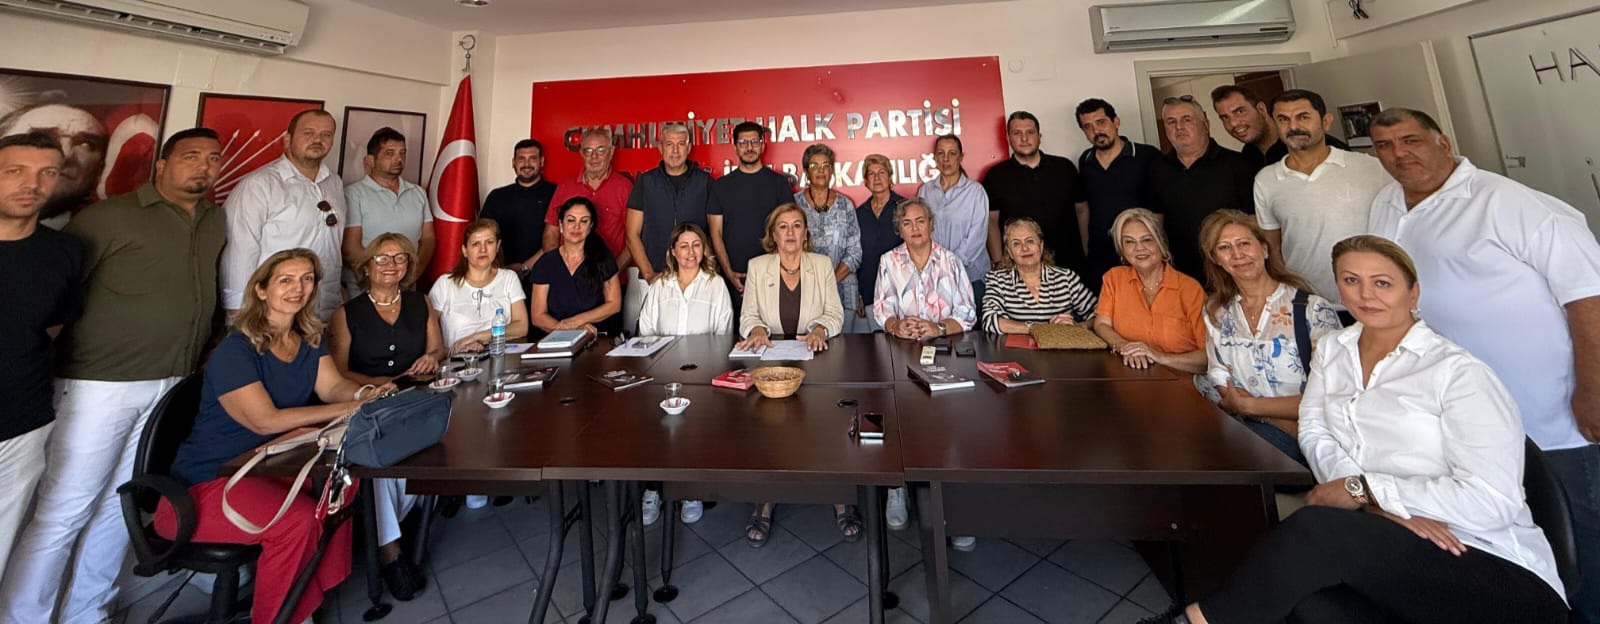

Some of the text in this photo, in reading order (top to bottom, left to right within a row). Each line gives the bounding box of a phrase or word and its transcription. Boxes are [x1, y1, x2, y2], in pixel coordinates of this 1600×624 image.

[563, 98, 962, 152] CMHUİYE HALK PARTİSİ
